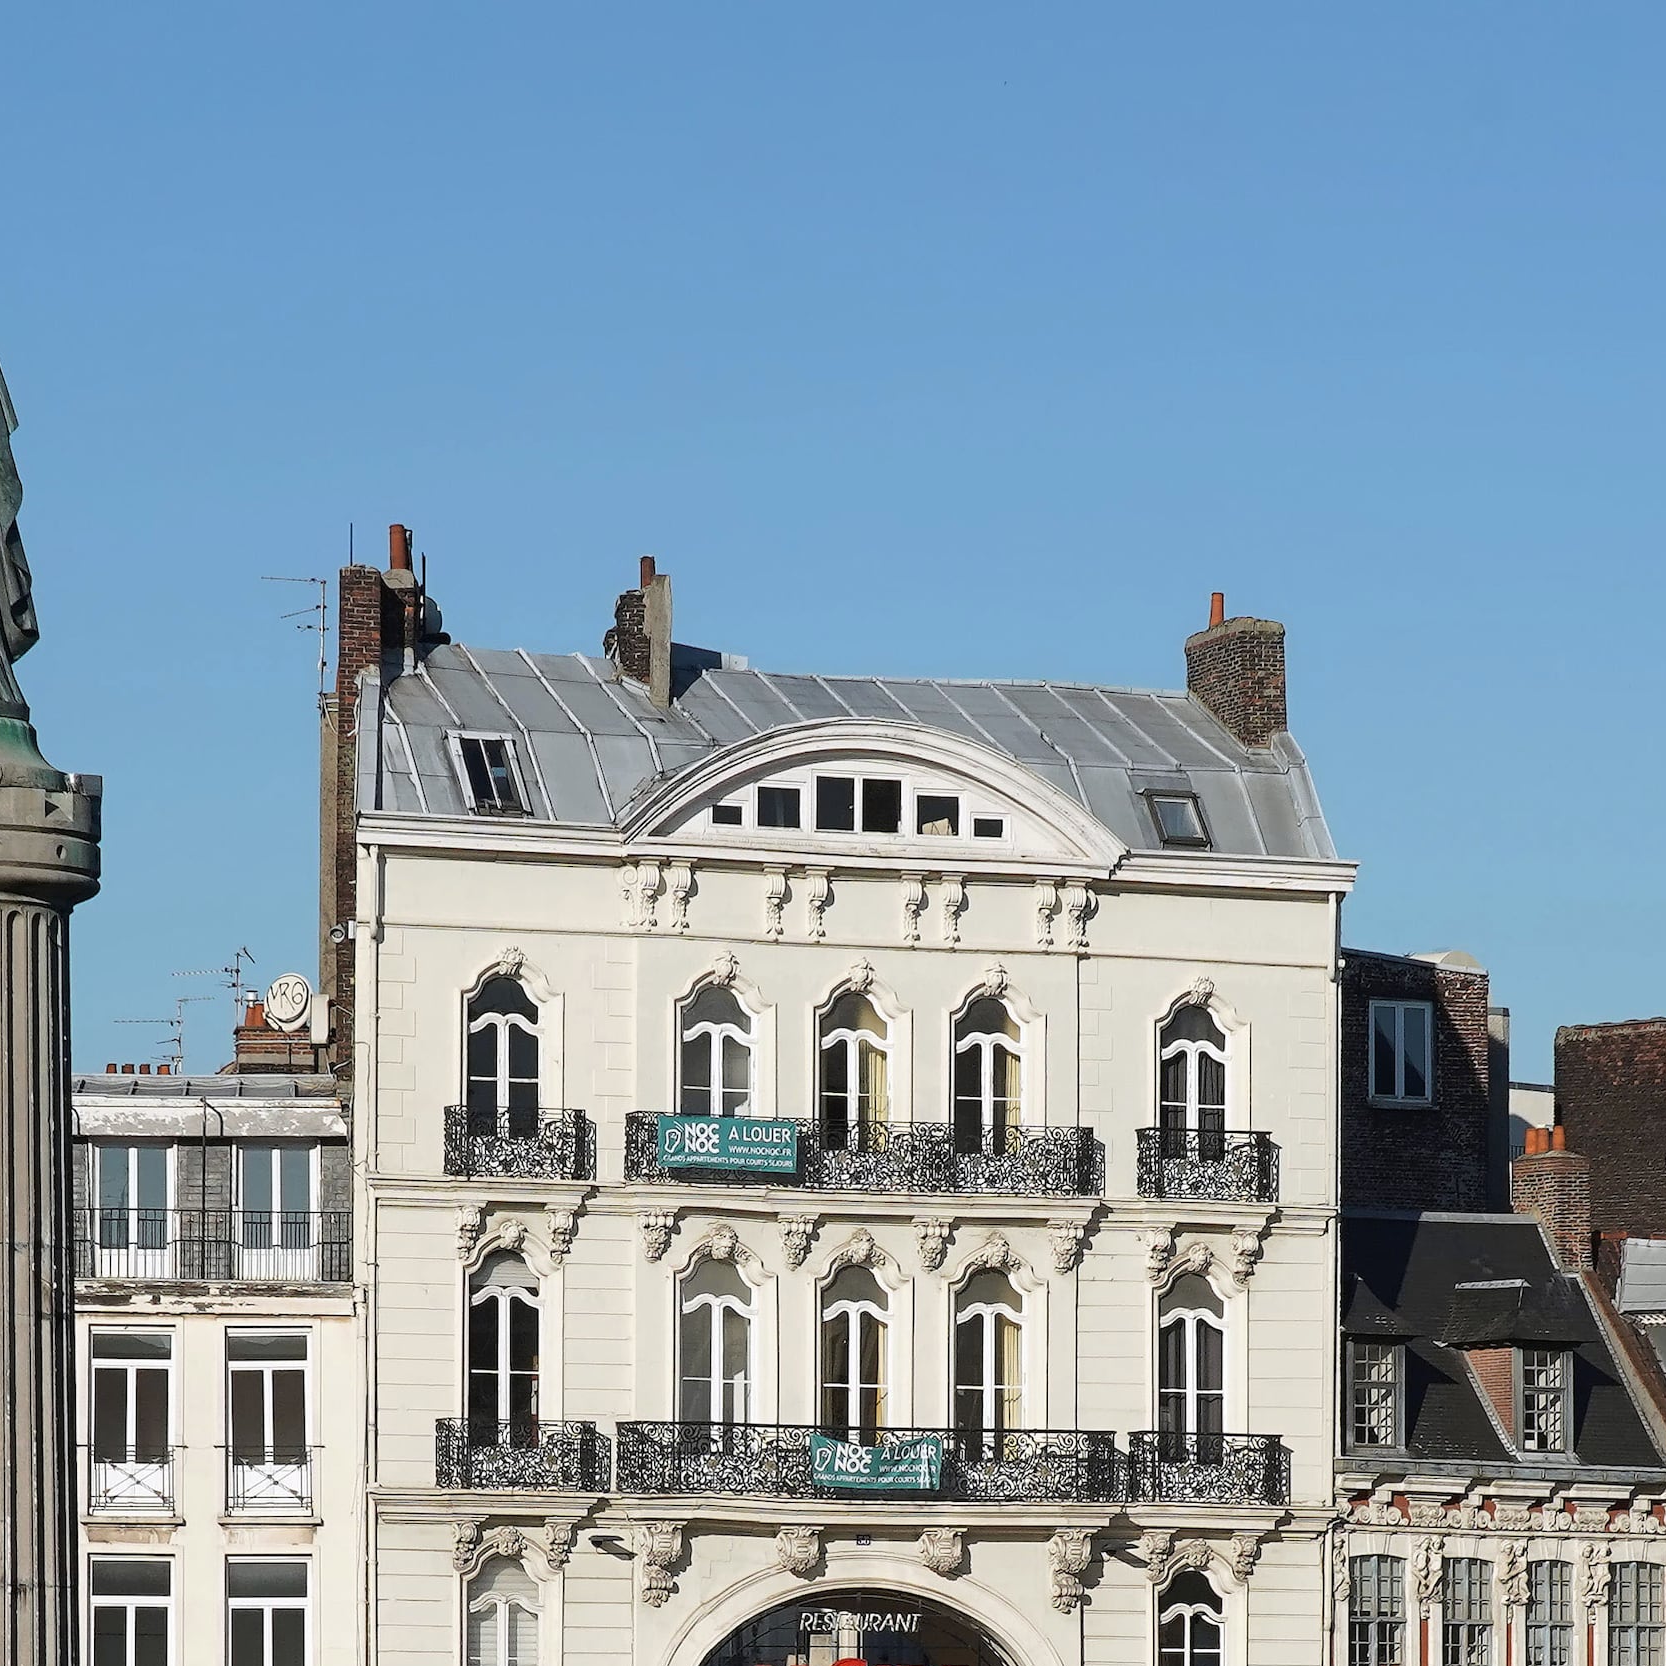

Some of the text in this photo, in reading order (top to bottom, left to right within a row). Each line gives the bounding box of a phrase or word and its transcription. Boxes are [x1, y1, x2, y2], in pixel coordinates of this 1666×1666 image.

[684, 1122, 720, 1139] NOC
[728, 1125, 792, 1143] A LOUER
[684, 1137, 720, 1154] NOC
[836, 1442, 874, 1460] NOC
[881, 1442, 937, 1461] A LOUER
[834, 1458, 872, 1474] NOC
[800, 1612, 923, 1633] RESTAURANT
